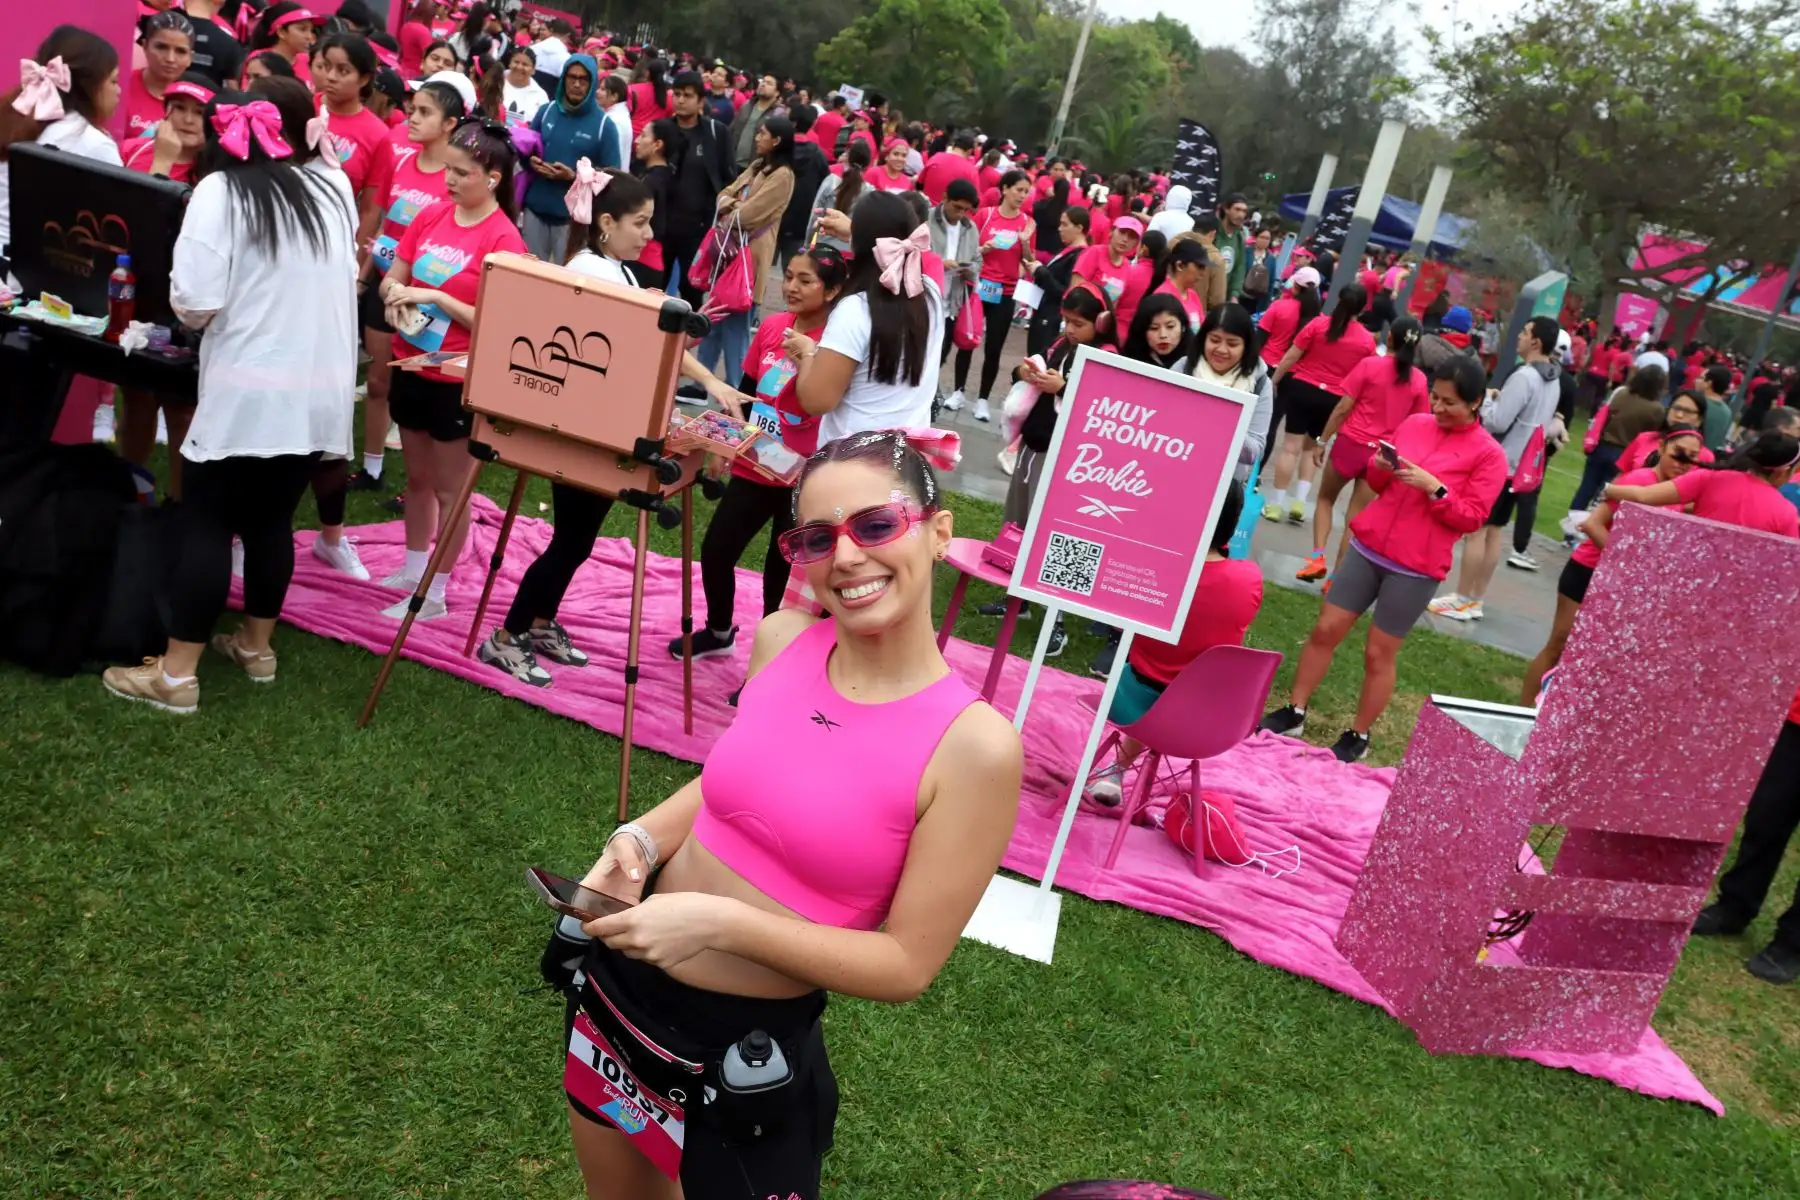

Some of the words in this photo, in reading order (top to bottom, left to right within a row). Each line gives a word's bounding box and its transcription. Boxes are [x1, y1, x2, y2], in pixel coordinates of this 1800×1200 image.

[513, 372, 560, 397] DOUBLE
[1086, 396, 1157, 426] ¡MUY
[1082, 415, 1195, 461] PRONTO!
[1065, 443, 1153, 497] Barbie
[621, 1097, 649, 1127] RUN
